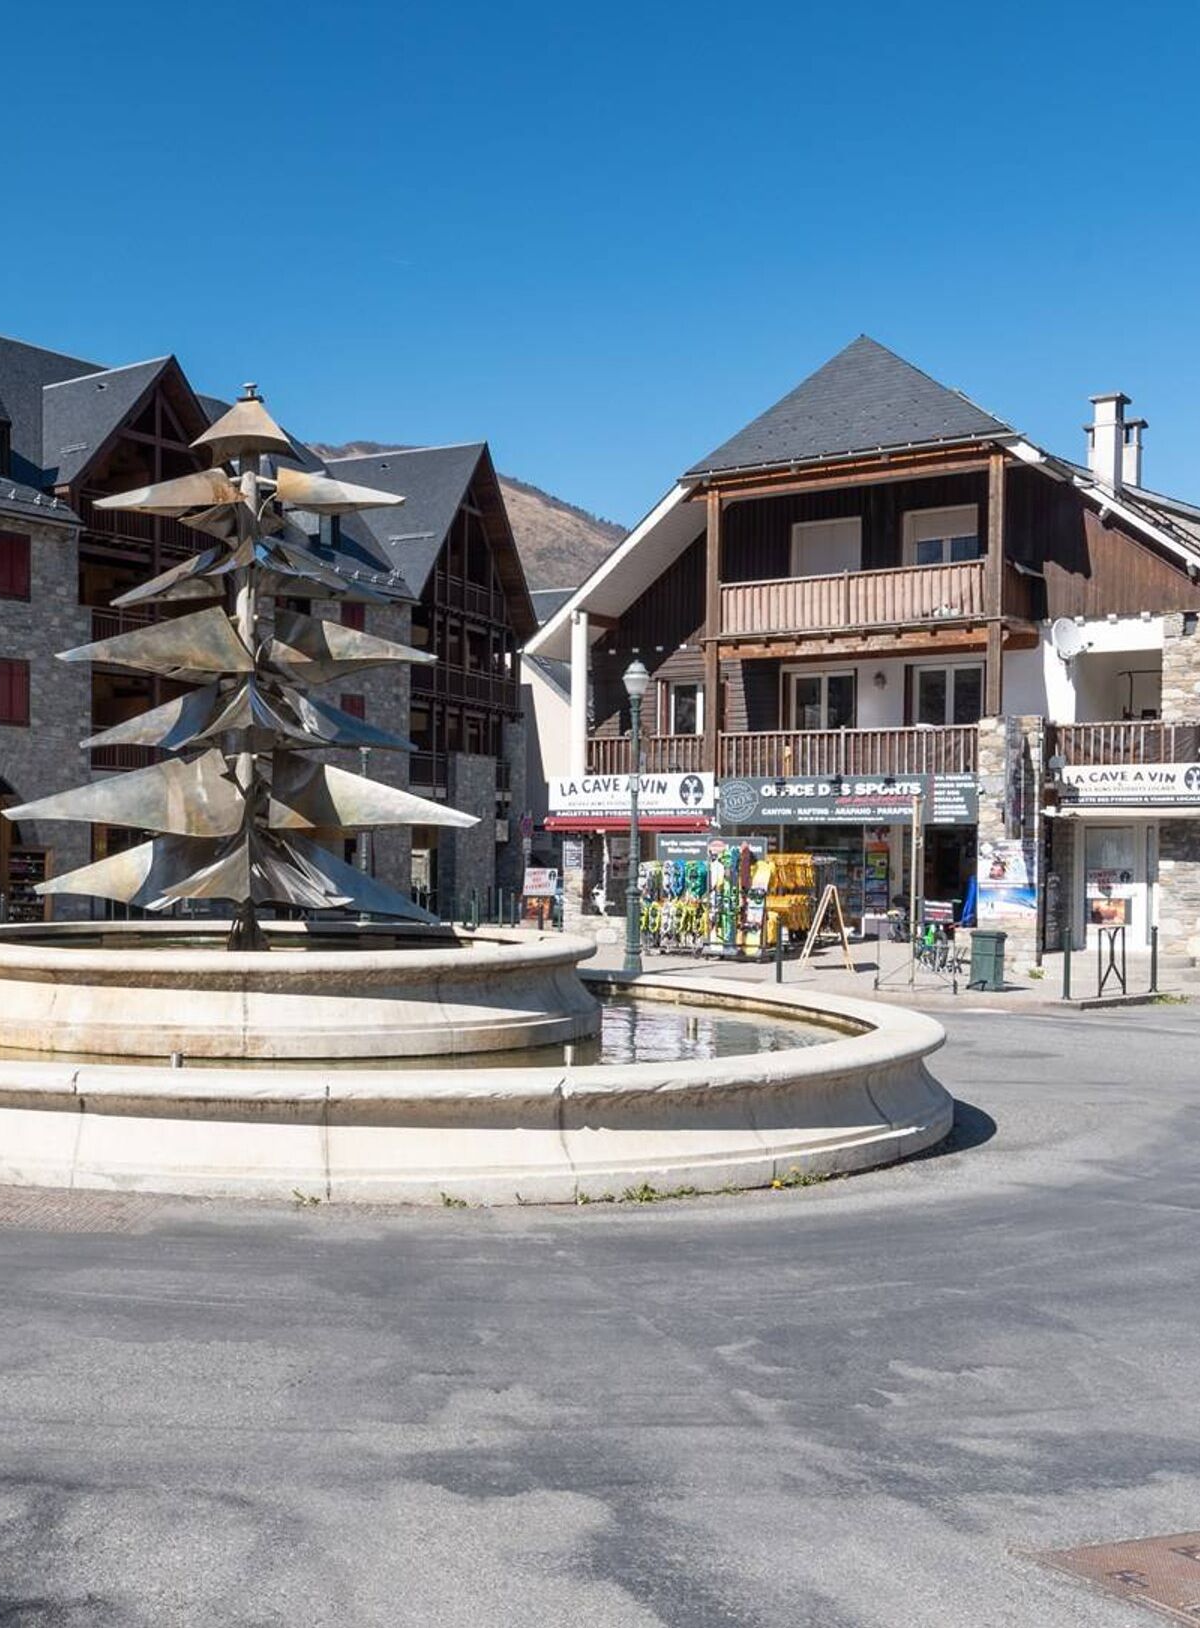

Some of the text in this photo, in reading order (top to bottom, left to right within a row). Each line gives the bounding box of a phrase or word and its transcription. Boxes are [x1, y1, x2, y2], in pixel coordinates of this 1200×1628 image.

[1089, 772, 1128, 783] CAVE
[1134, 772, 1144, 781] A
[1148, 772, 1176, 784] VIN
[560, 782, 578, 796] LA
[582, 779, 620, 793] CAVE
[640, 779, 668, 794] VIN
[818, 783, 851, 797] DES
[855, 782, 922, 796] SPORTS
